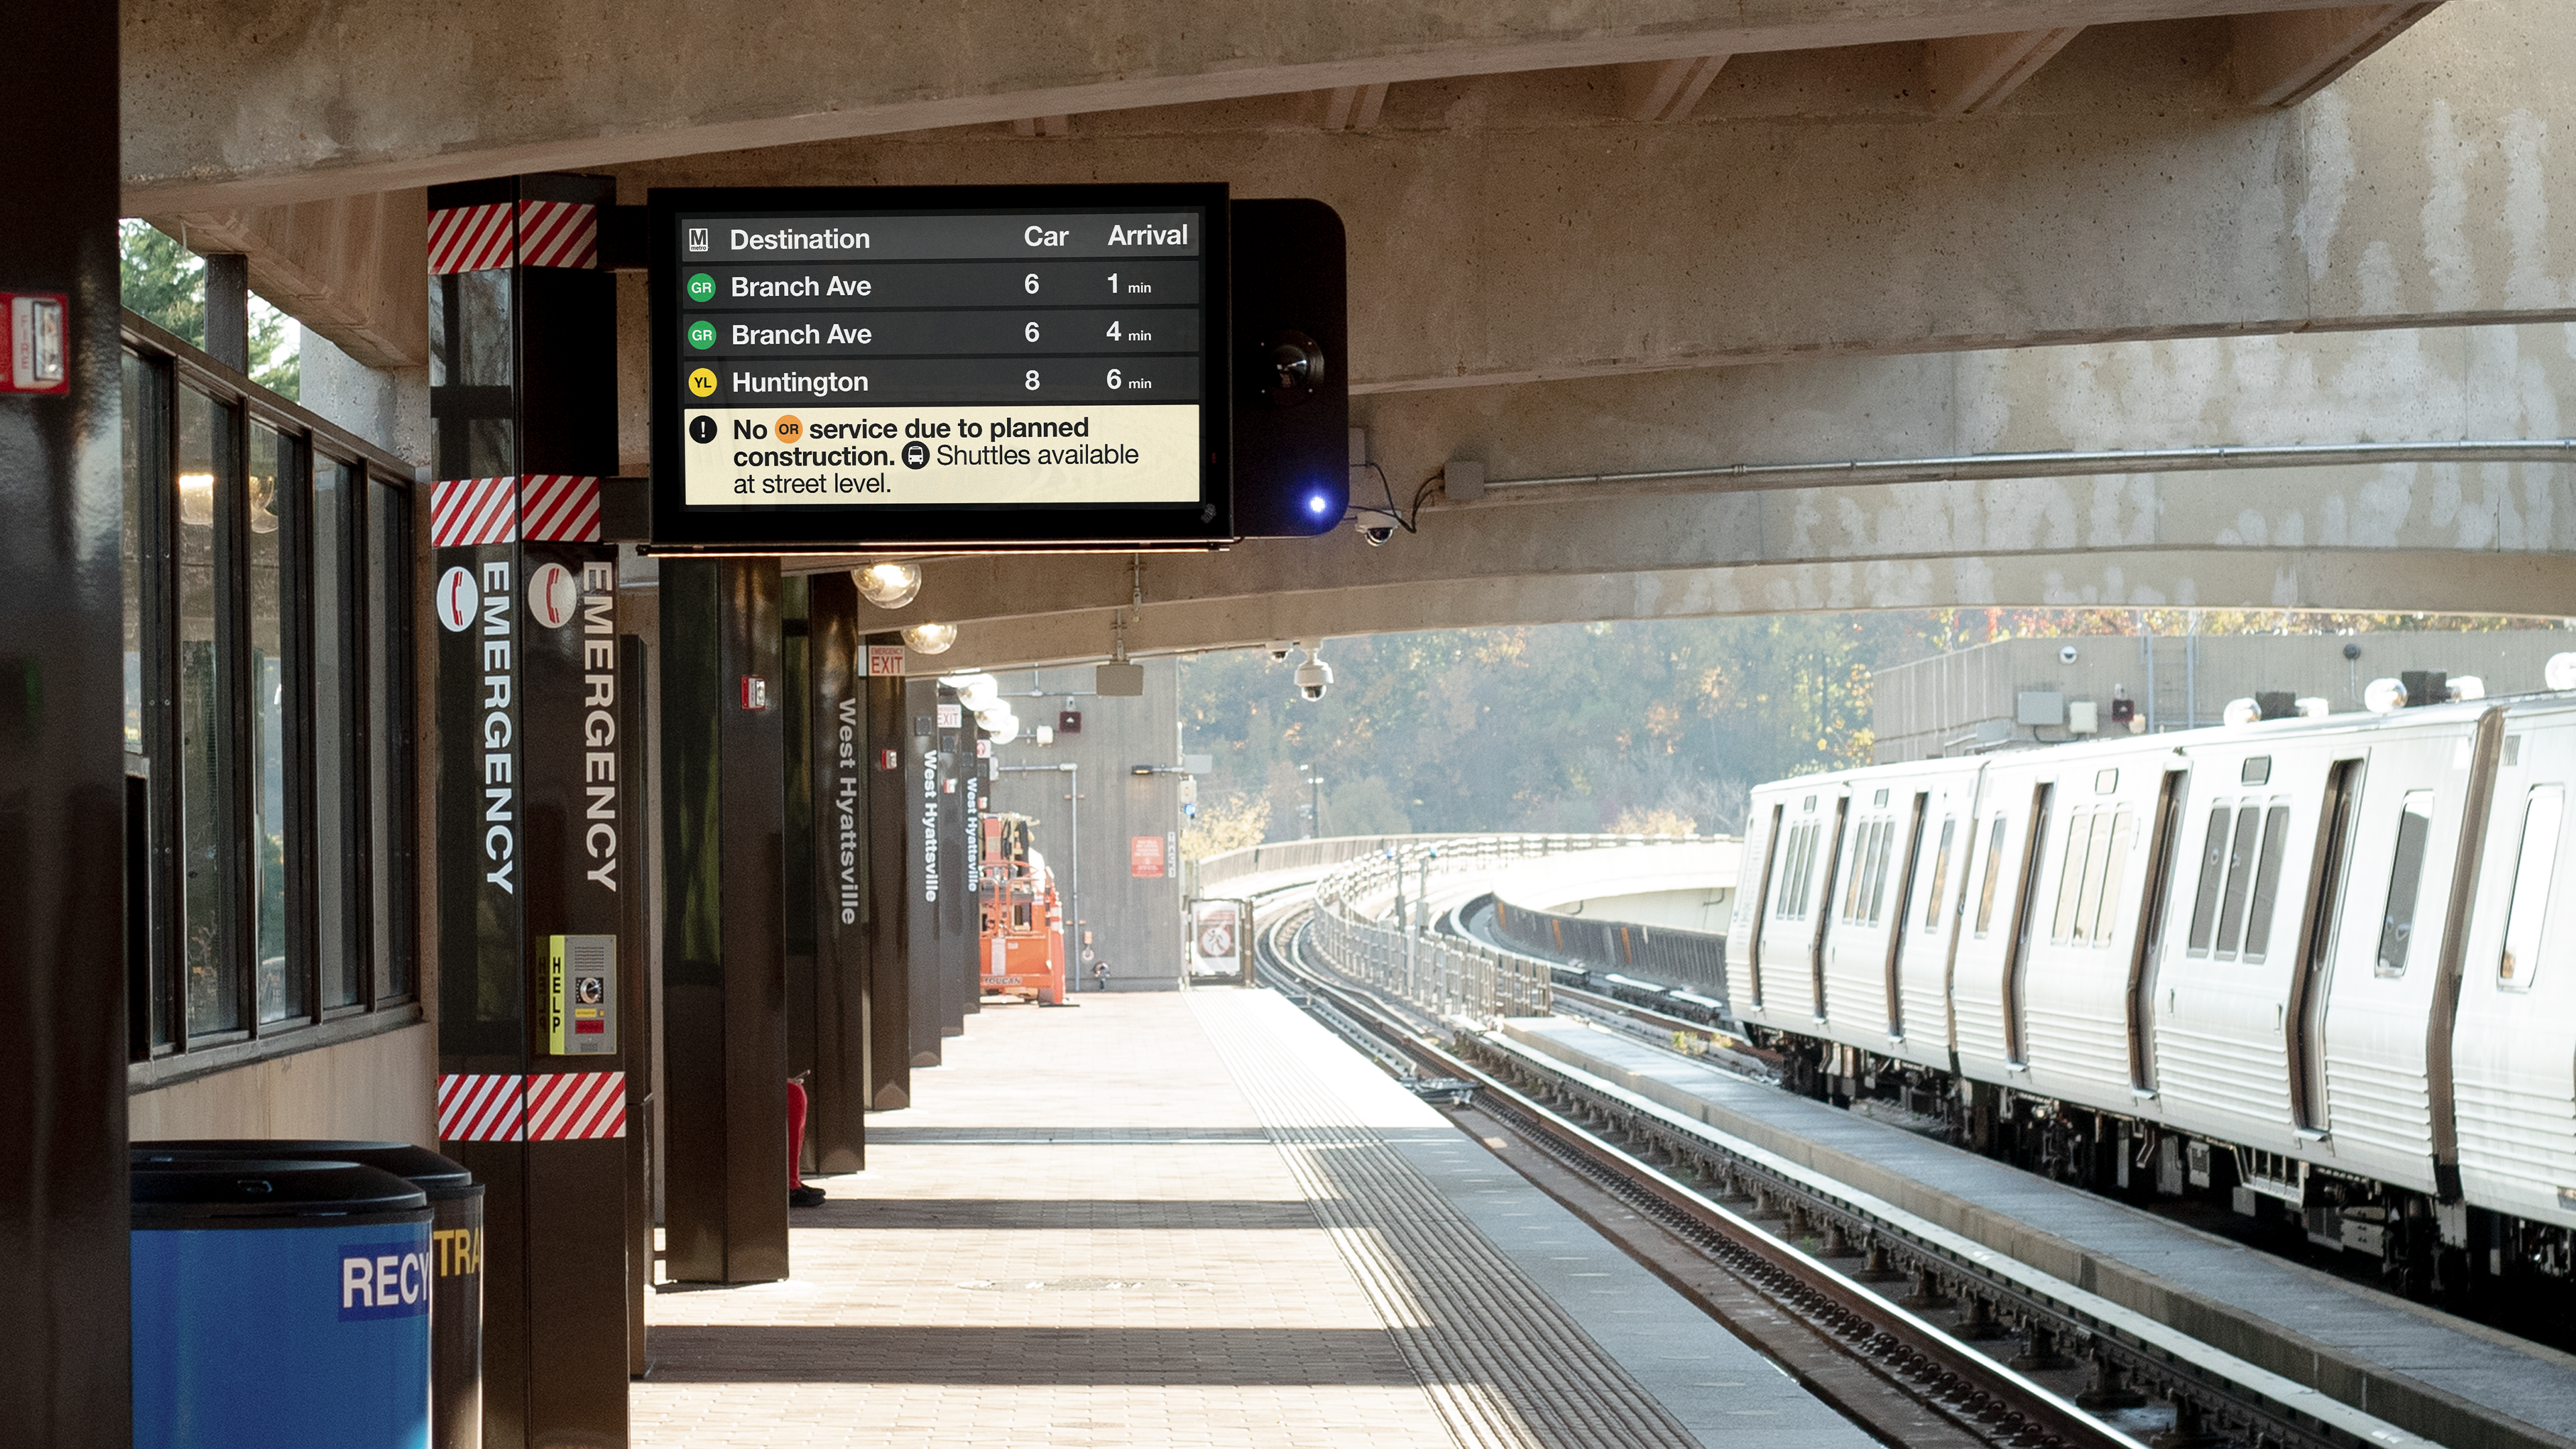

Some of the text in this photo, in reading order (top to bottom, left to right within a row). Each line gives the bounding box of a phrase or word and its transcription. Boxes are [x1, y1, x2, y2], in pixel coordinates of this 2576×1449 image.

[731, 224, 1188, 250] Destination Car Arrival
[692, 273, 1152, 297] GR Branch Ave 6 1 min
[692, 321, 1152, 345] GR Branch Ave 6 4 min
[694, 369, 1152, 397] YL Huntington 8 6 min
[734, 417, 1089, 443] No OR service due to planned
[733, 443, 1139, 467] construction. Shuttles available
[734, 472, 891, 494] at street level.
[871, 656, 903, 674] EXIT
[484, 561, 513, 895] EMERGENCY
[583, 561, 616, 892] EMERGENCY
[938, 713, 958, 724] EXIT
[836, 698, 859, 924] West Hyattsville
[922, 749, 938, 902] West Hyattsville
[965, 777, 978, 892] West Hyattsville
[553, 957, 561, 1033] HELP
[343, 1252, 429, 1308] RECY
